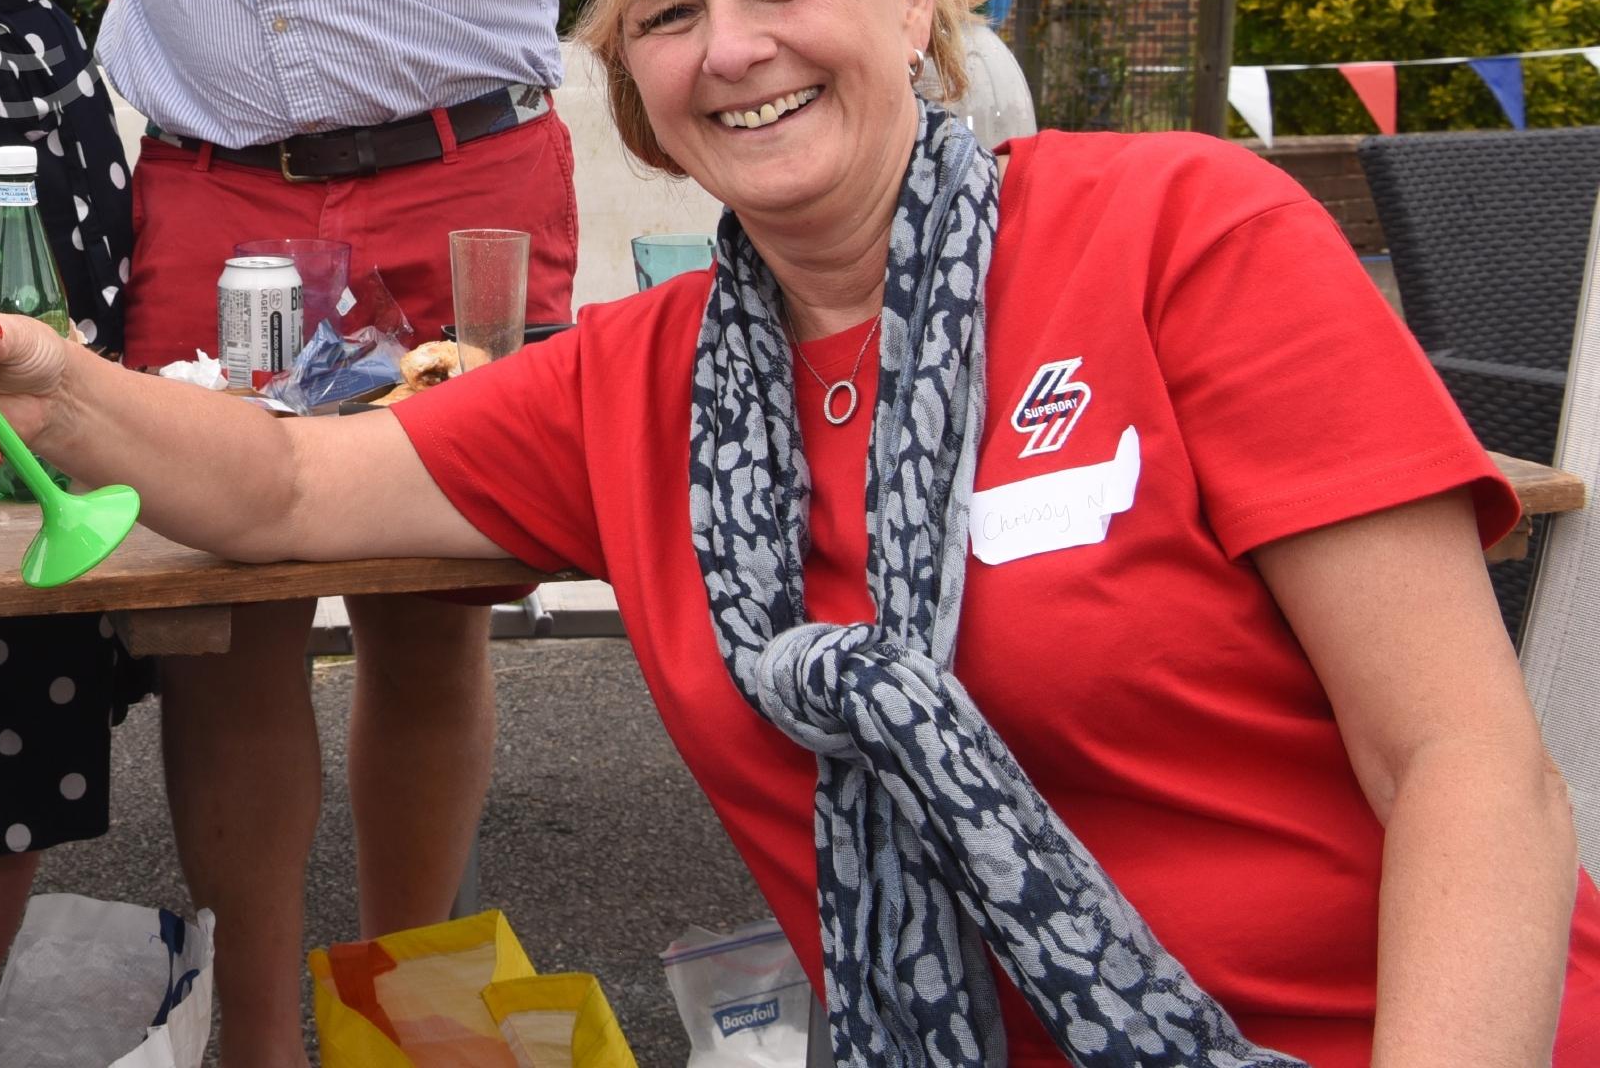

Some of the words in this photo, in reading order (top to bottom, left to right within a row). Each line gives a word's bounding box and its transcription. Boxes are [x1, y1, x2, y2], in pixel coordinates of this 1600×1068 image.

[260, 289, 268, 318] LAGER
[260, 320, 268, 339] LIKE
[260, 341, 268, 350] IT
[1024, 398, 1078, 419] SUPERDRY
[721, 1002, 777, 1030] Bacofoil
